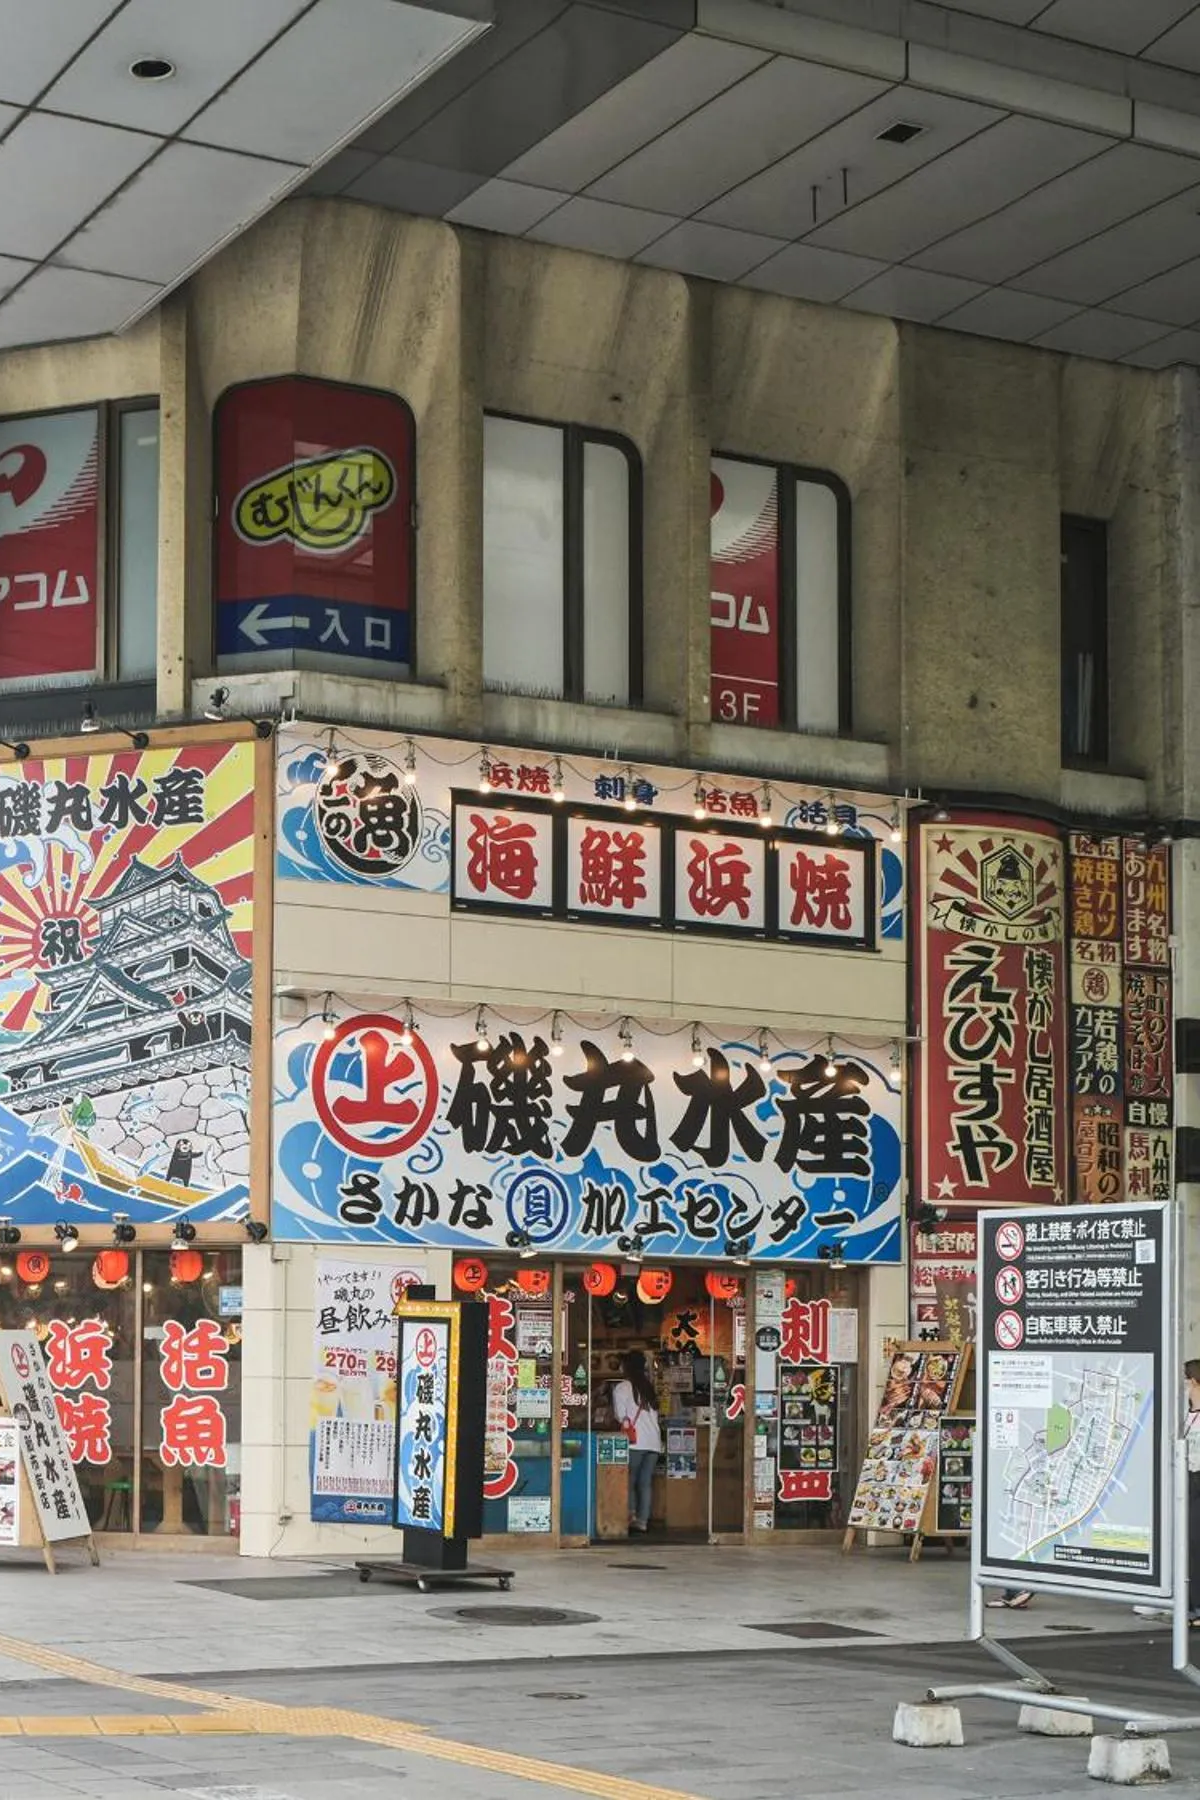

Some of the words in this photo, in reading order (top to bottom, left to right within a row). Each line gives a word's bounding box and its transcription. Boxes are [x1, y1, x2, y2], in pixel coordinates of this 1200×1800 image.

[250, 458, 384, 537] むじんくん
[318, 608, 391, 650] 入口
[719, 690, 761, 723] 3F
[467, 813, 852, 931] 海鮮浜焼
[1096, 858, 1117, 937] 串カツ
[1125, 852, 1146, 961] あります
[1146, 854, 1167, 964] 九州名物
[40, 919, 85, 966] 祝
[1075, 941, 1117, 963] 名物
[943, 940, 1018, 1187] えびすや
[1023, 946, 1057, 1188] 懐かし居酒屋
[1075, 1005, 1093, 1095] カラアゲ
[1093, 1009, 1119, 1095] 若鶏の
[446, 1031, 874, 1177] 磯丸水産
[1127, 1101, 1169, 1127] 自慢
[1096, 1121, 1120, 1203] 昭和の
[581, 1181, 857, 1244] 加工センター
[1025, 1217, 1146, 1242] 路上禁煙・ポイ捨て禁止
[1025, 1267, 1143, 1289] 客引き行為等禁止
[316, 1303, 392, 1336] 昼飲み
[1025, 1315, 1128, 1336] 自転車乗入禁止
[47, 1317, 113, 1465] 浜焼
[159, 1318, 230, 1468] 活魚
[324, 1352, 368, 1370] 270円
[22, 1381, 72, 1520] 磯丸水産
[411, 1371, 435, 1522] 磯丸水産
